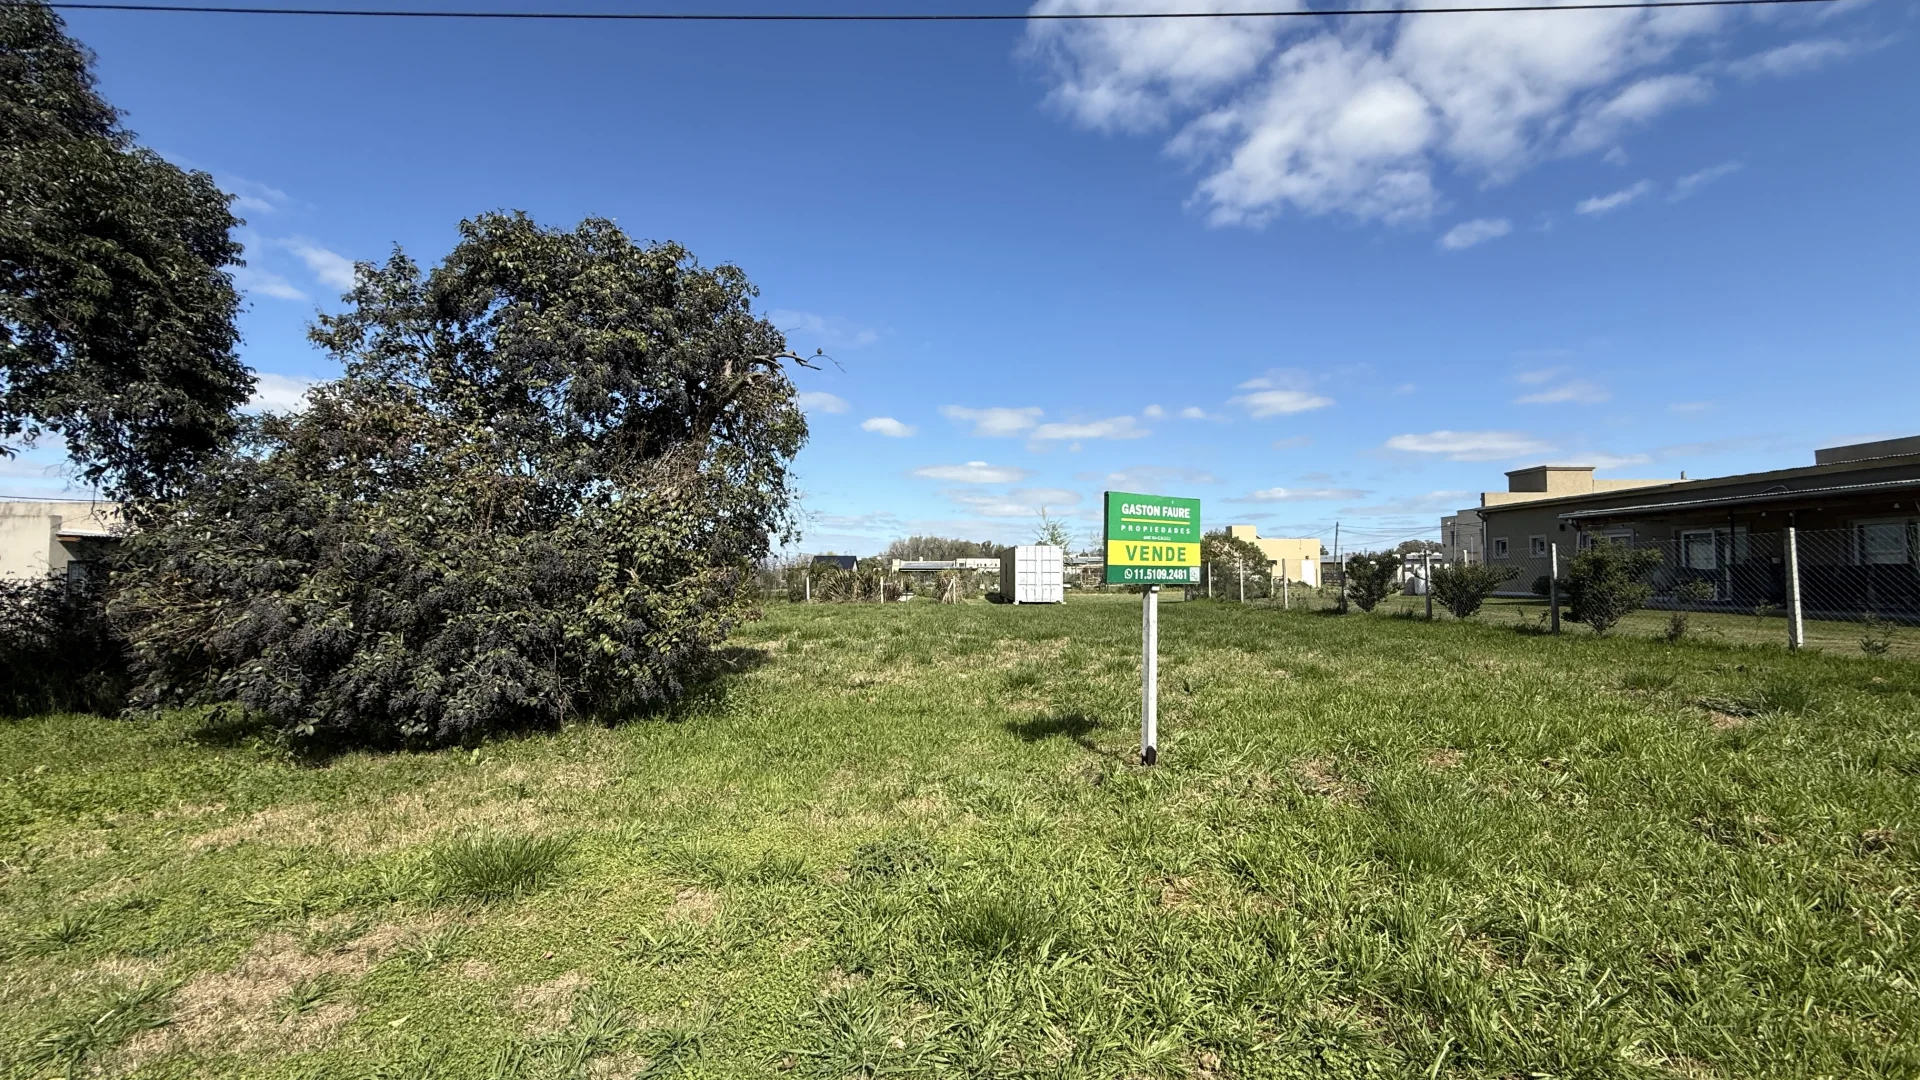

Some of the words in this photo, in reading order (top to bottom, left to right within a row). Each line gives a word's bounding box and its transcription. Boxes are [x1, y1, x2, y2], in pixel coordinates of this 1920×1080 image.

[1121, 503, 1160, 516] GASTON
[1162, 506, 1190, 518] FAURE
[1121, 525, 1190, 534] PROPIEDADES
[1125, 545, 1186, 562] VENDE
[1134, 568, 1187, 579] 11.5109.2481
